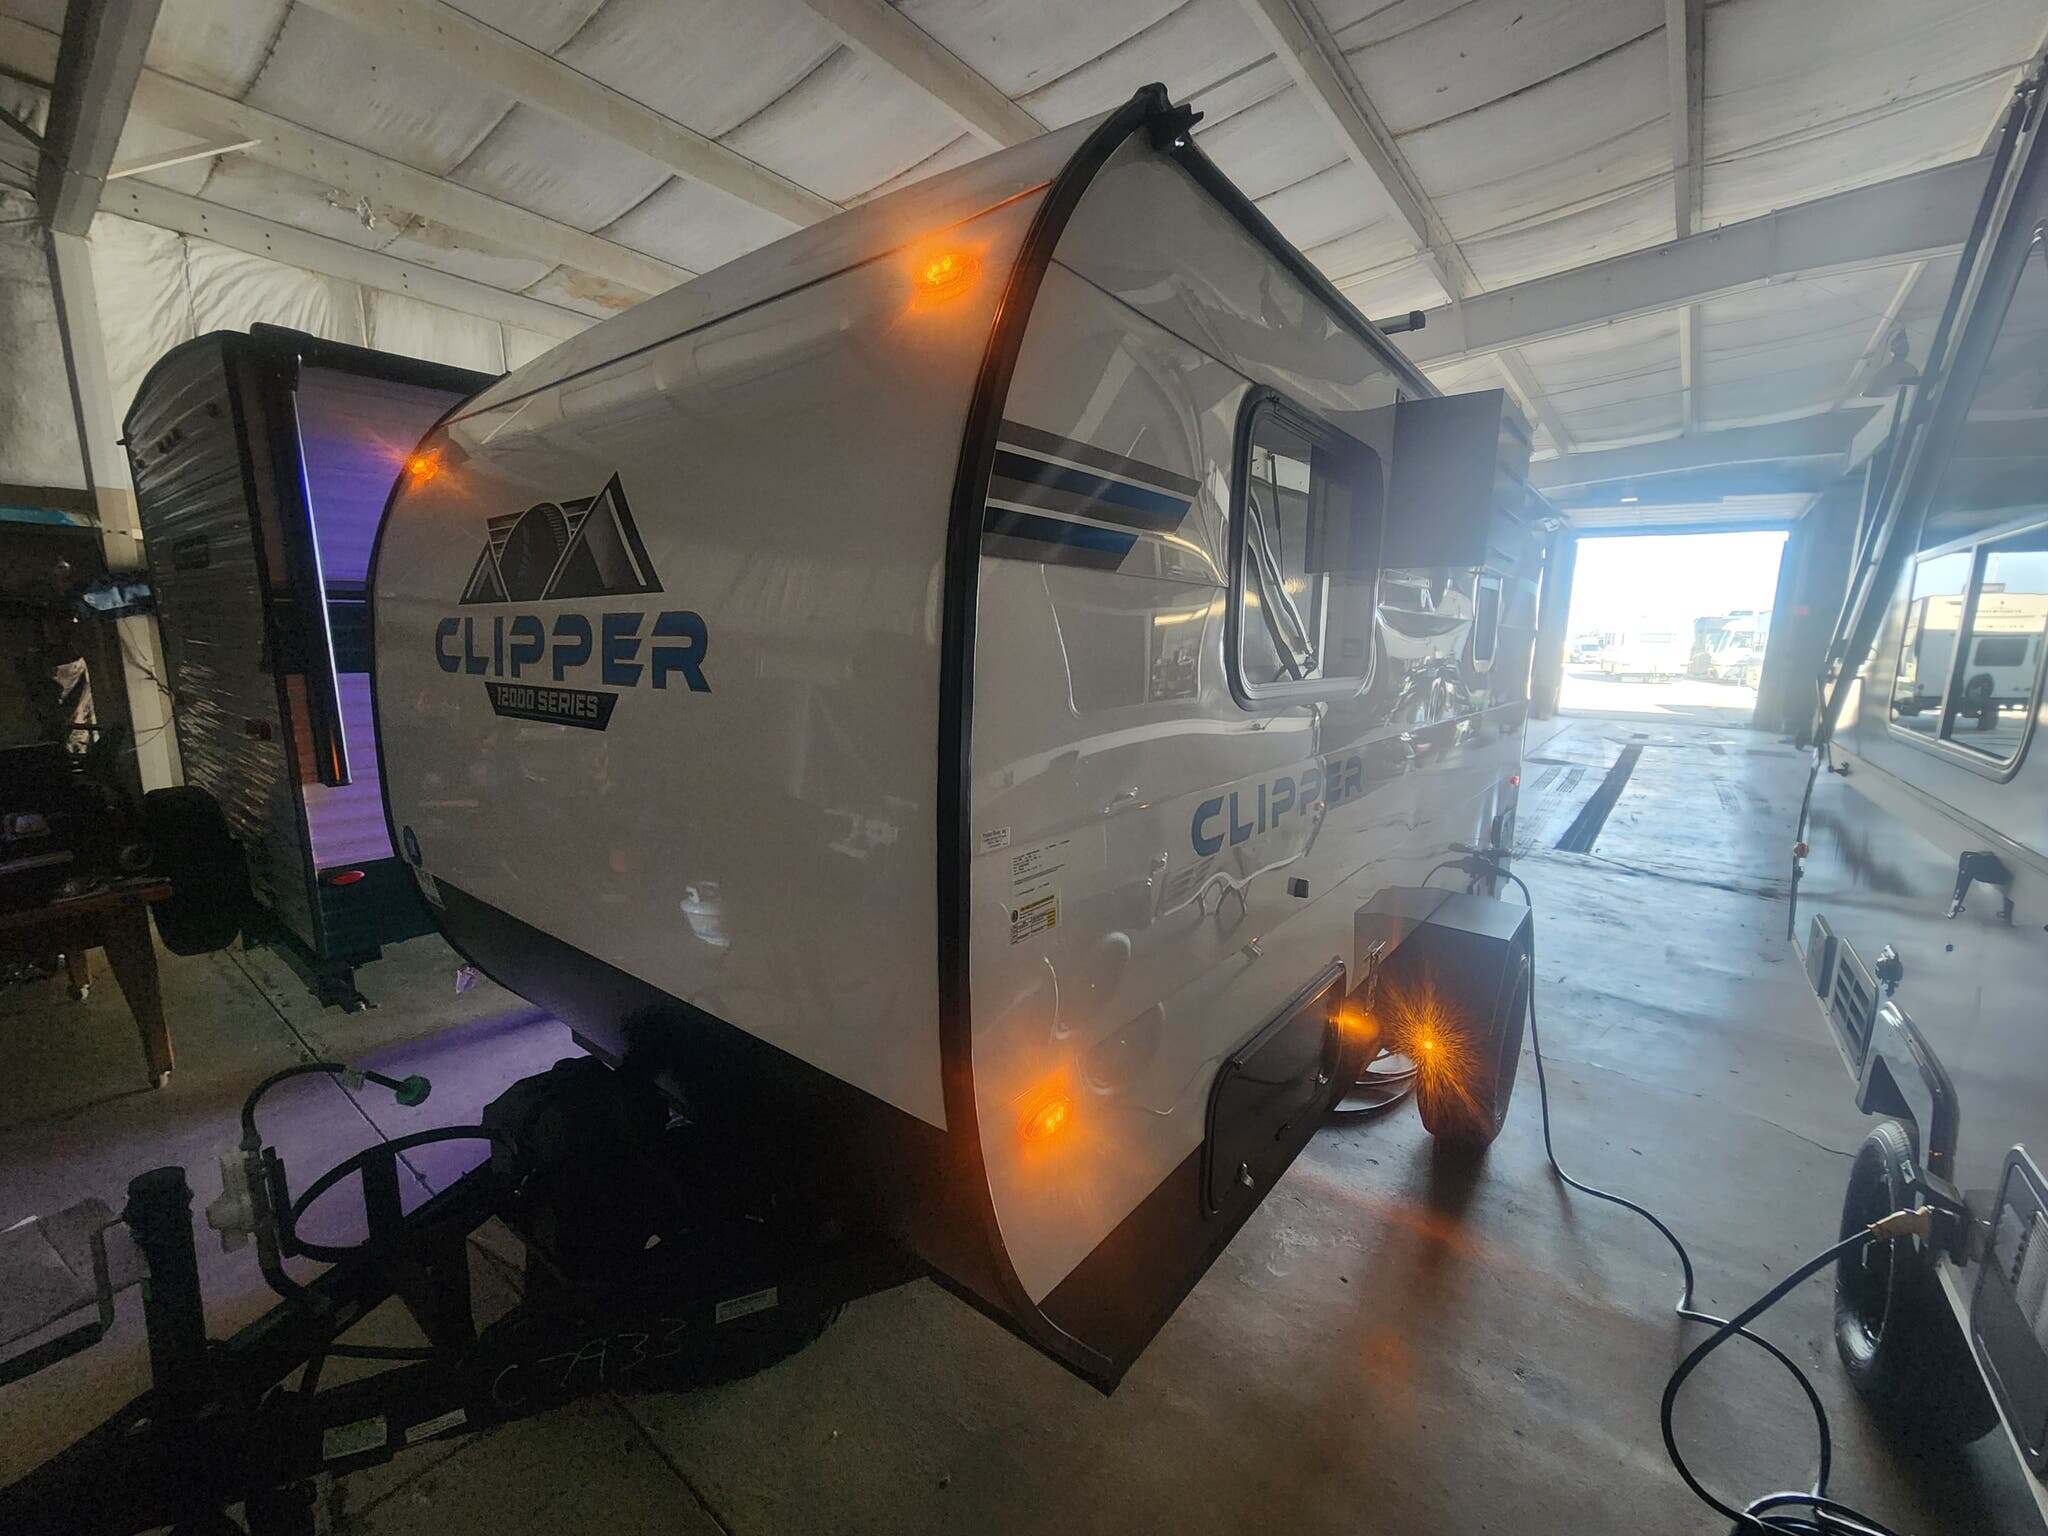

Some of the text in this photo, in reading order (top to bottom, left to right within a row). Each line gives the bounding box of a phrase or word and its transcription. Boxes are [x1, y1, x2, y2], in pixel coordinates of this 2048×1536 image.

[435, 611, 712, 694] CLIPPER
[498, 687, 599, 718] 12000 SERIES
[1191, 755, 1363, 857] CLIPPER
